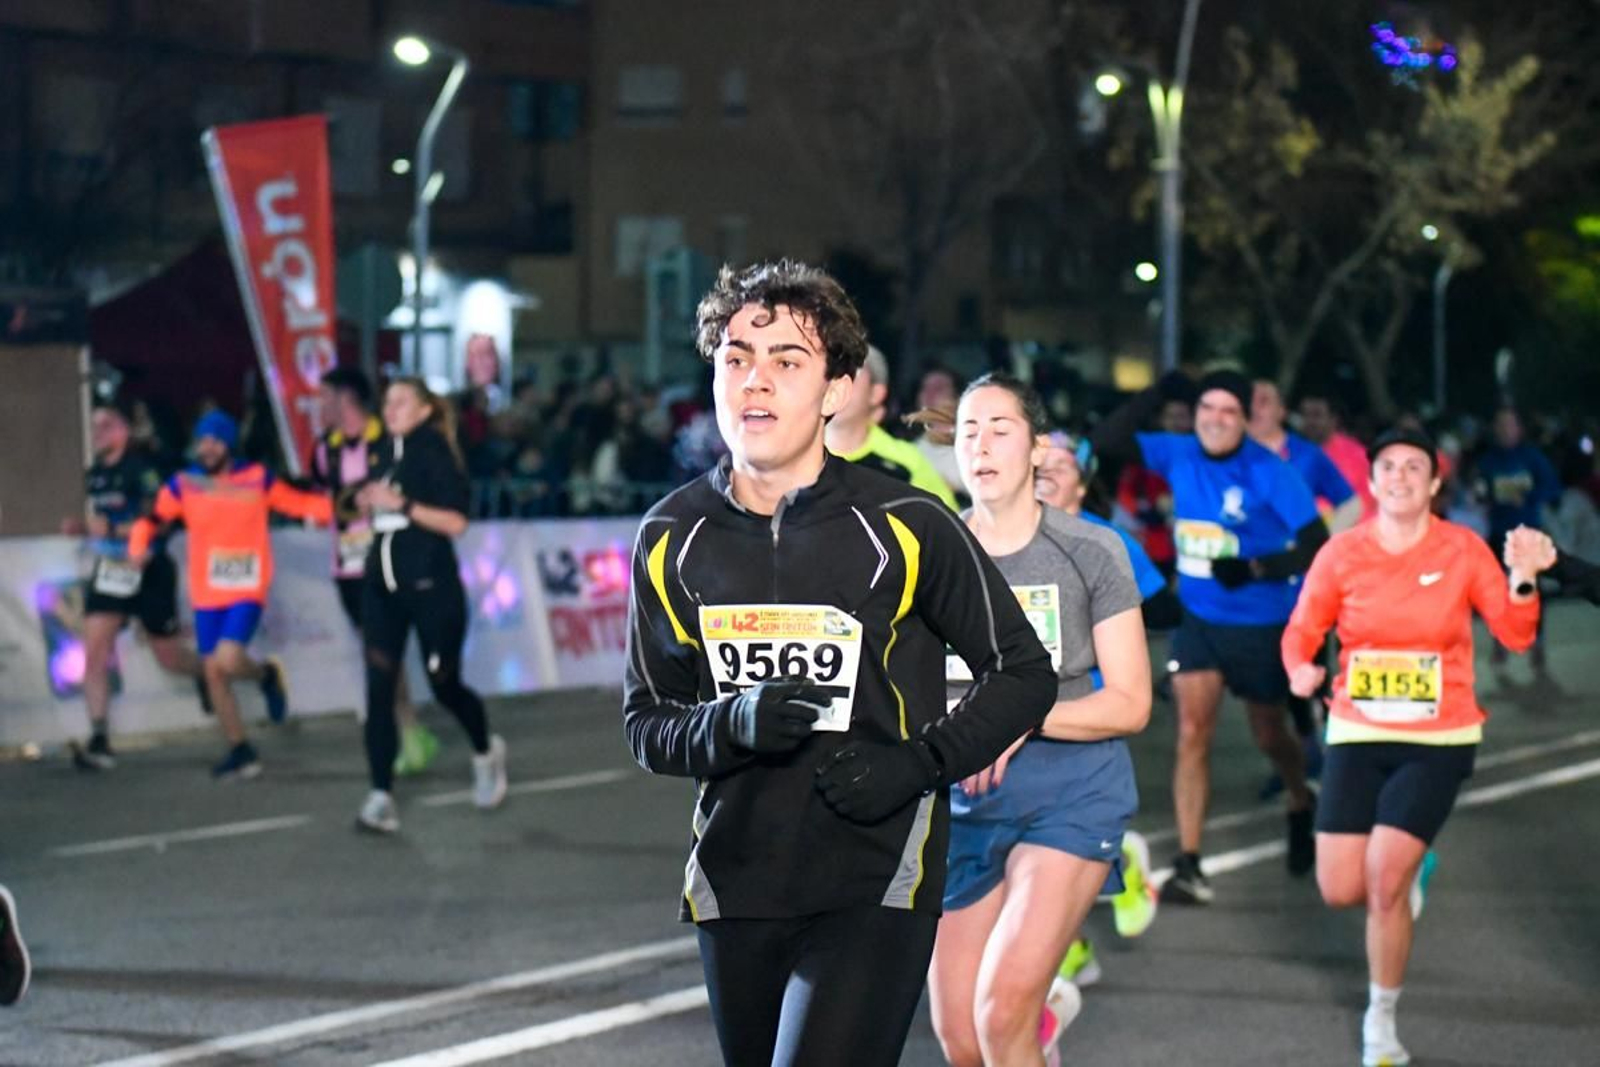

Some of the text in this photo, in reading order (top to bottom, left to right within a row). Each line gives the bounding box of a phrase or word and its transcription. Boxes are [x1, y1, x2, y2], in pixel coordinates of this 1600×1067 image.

[731, 612, 759, 632] 42
[718, 642, 843, 683] 9569
[1358, 671, 1430, 696] 3155
